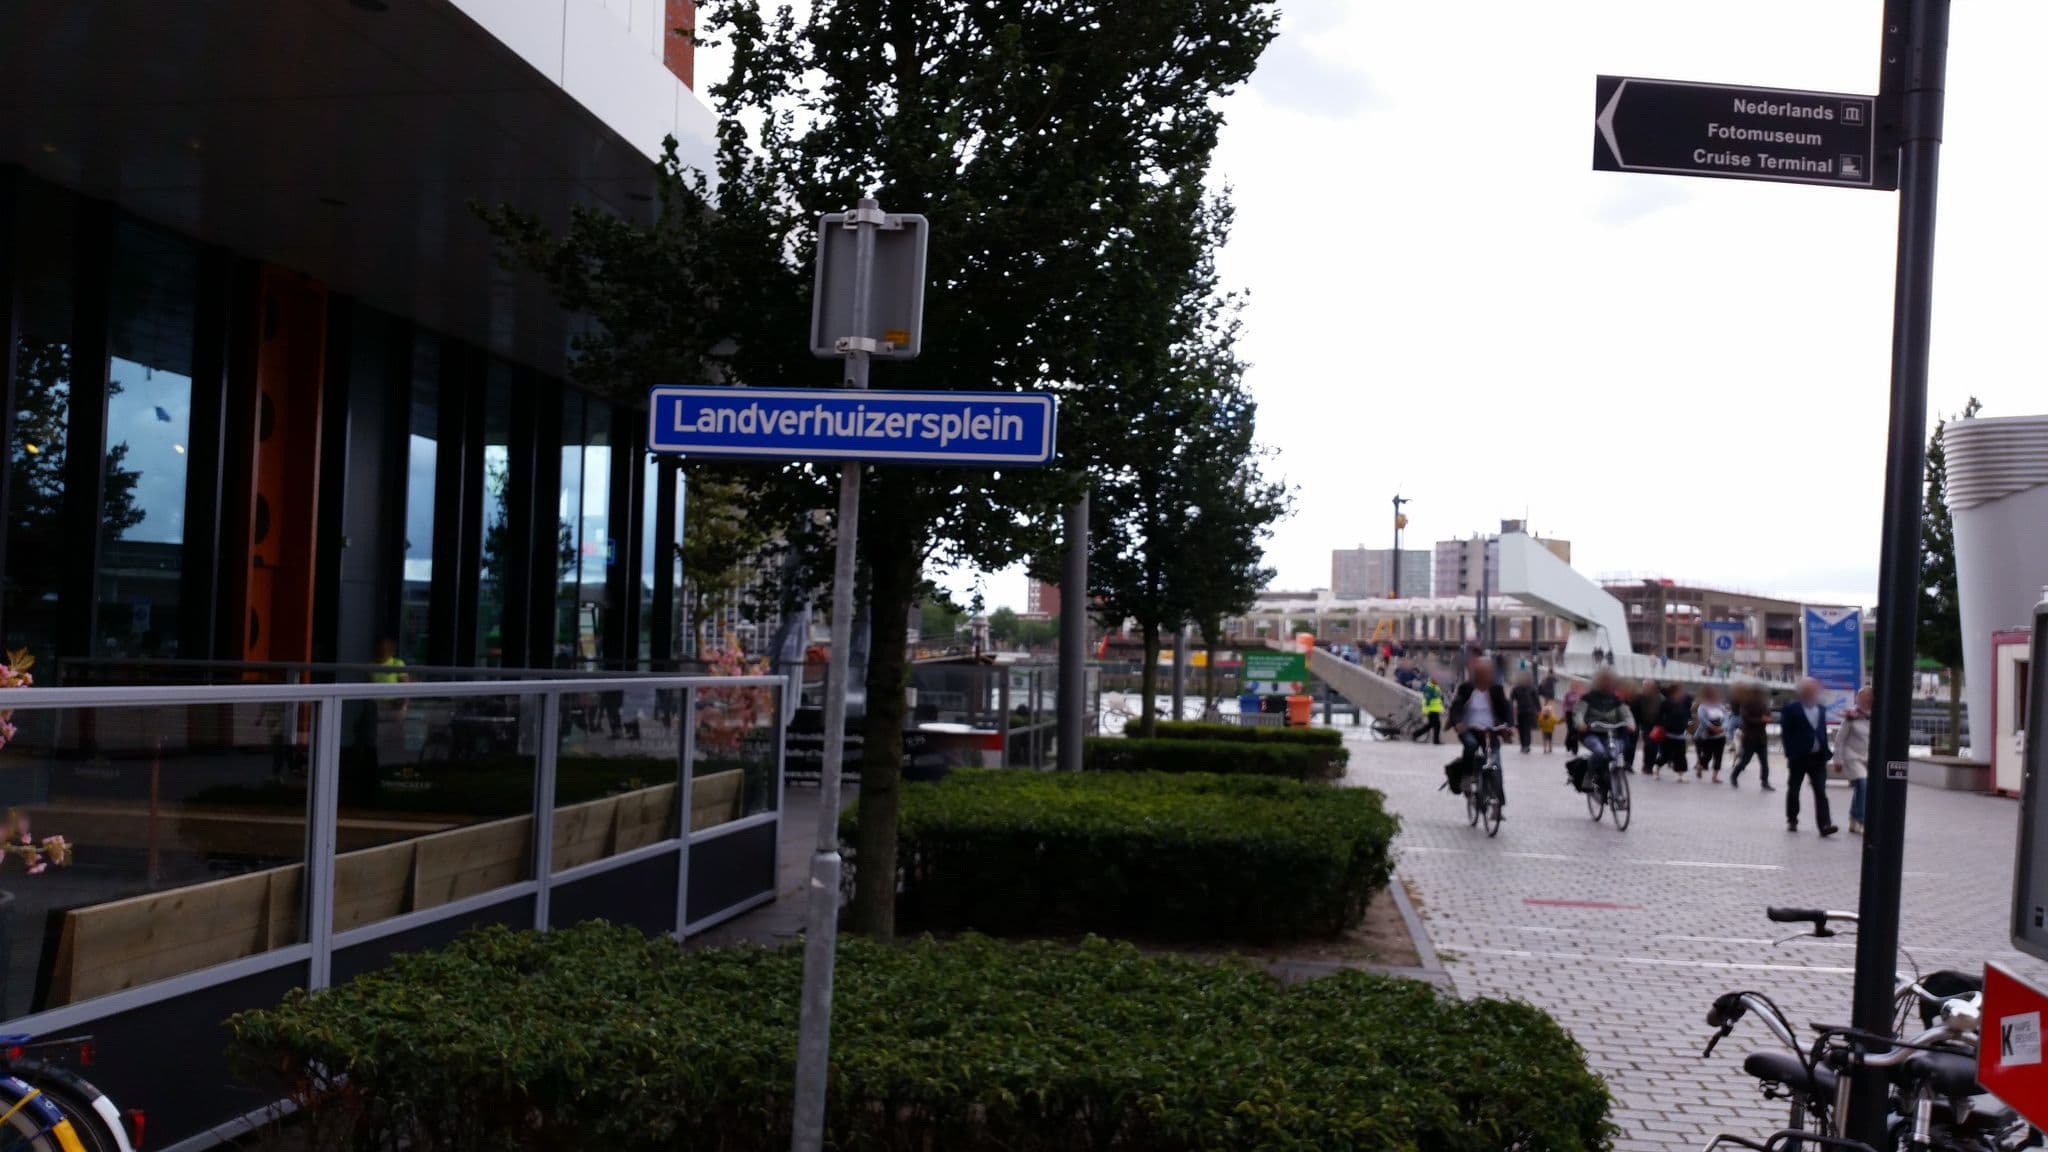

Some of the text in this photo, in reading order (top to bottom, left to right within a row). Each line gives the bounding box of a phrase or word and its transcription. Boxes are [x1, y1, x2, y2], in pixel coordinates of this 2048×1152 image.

[1734, 98, 1833, 120] Nederlands
[1708, 123, 1822, 145] Fotomuseum
[1693, 149, 1833, 173] Cruise Terminal
[674, 400, 1024, 447] Landverhuizersplein
